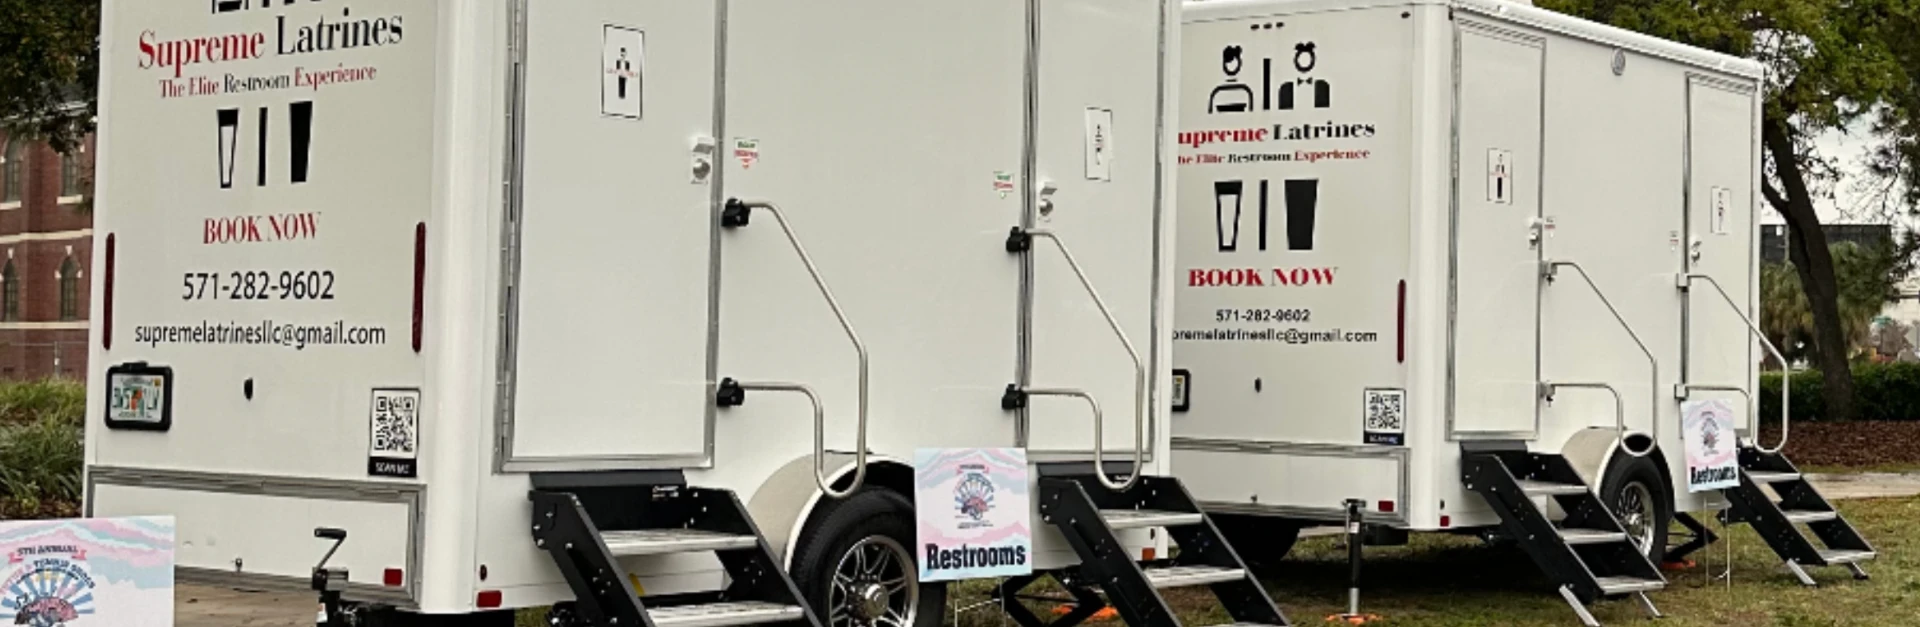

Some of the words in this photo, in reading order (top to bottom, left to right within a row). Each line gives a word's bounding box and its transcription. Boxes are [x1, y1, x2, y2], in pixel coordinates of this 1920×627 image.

[138, 29, 265, 77] Supreme
[275, 7, 403, 56] Latrines
[159, 78, 185, 99] The
[188, 76, 219, 96] Elite
[224, 72, 290, 94] Restroom
[294, 62, 377, 91] Experience
[1178, 127, 1268, 148] upreme
[1273, 121, 1375, 140] Latrines
[1178, 154, 1193, 165] he
[1196, 153, 1225, 164] Elite
[1227, 151, 1291, 163] Restroom
[1294, 149, 1370, 163] Experience
[203, 216, 262, 244] BOOK
[267, 211, 321, 241] NOW
[182, 270, 335, 300] 571-282-9602
[1188, 269, 1264, 287] BOOK
[1270, 267, 1338, 286] NOW
[1216, 309, 1311, 322] 571-282-9602
[135, 320, 386, 350] supremelatrinesllc@gmail.com
[1173, 328, 1377, 344] premelatrinesllc@gmail.com
[925, 543, 1026, 571] Restrooms
